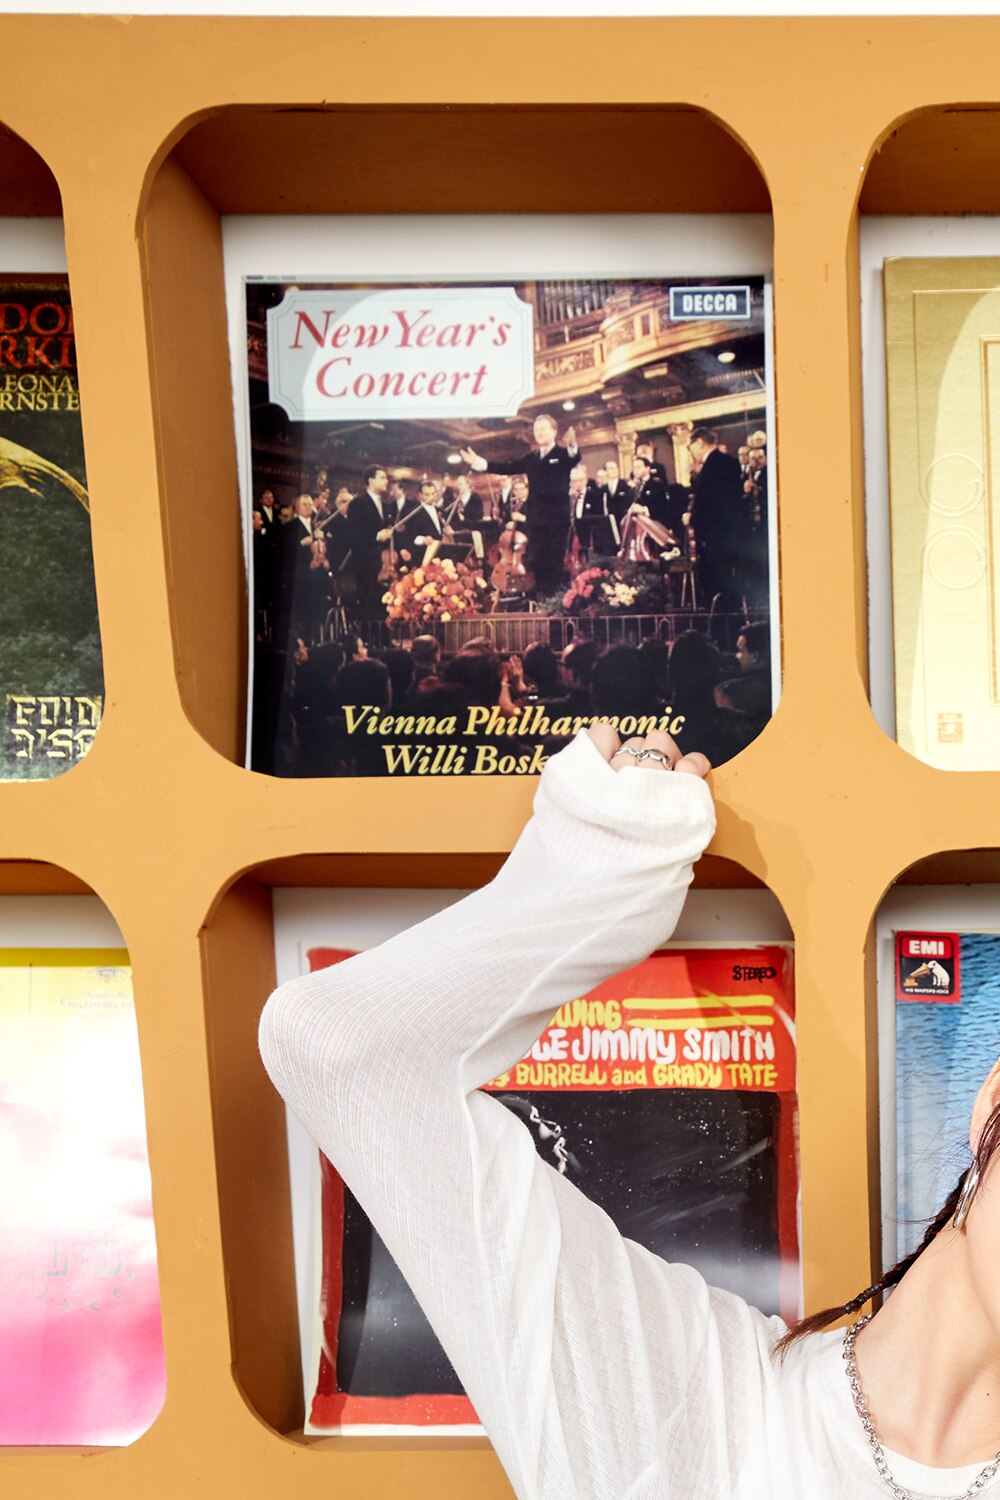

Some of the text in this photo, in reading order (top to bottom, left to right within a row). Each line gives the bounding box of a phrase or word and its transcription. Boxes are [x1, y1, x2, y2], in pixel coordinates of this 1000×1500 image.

[683, 294, 737, 313] DECCA
[289, 309, 512, 350] New Year's
[315, 357, 487, 399] Concert
[342, 705, 456, 736] Vienna
[382, 744, 466, 775] Willi
[909, 940, 944, 955] EMI
[732, 965, 777, 983] STEREO
[571, 1027, 675, 1063] JIMMY
[683, 1027, 775, 1061] SMITH
[516, 1063, 607, 1088] BURRELL
[611, 1065, 648, 1086] and
[653, 1063, 722, 1089] GRADY
[725, 1062, 778, 1088] TATE
